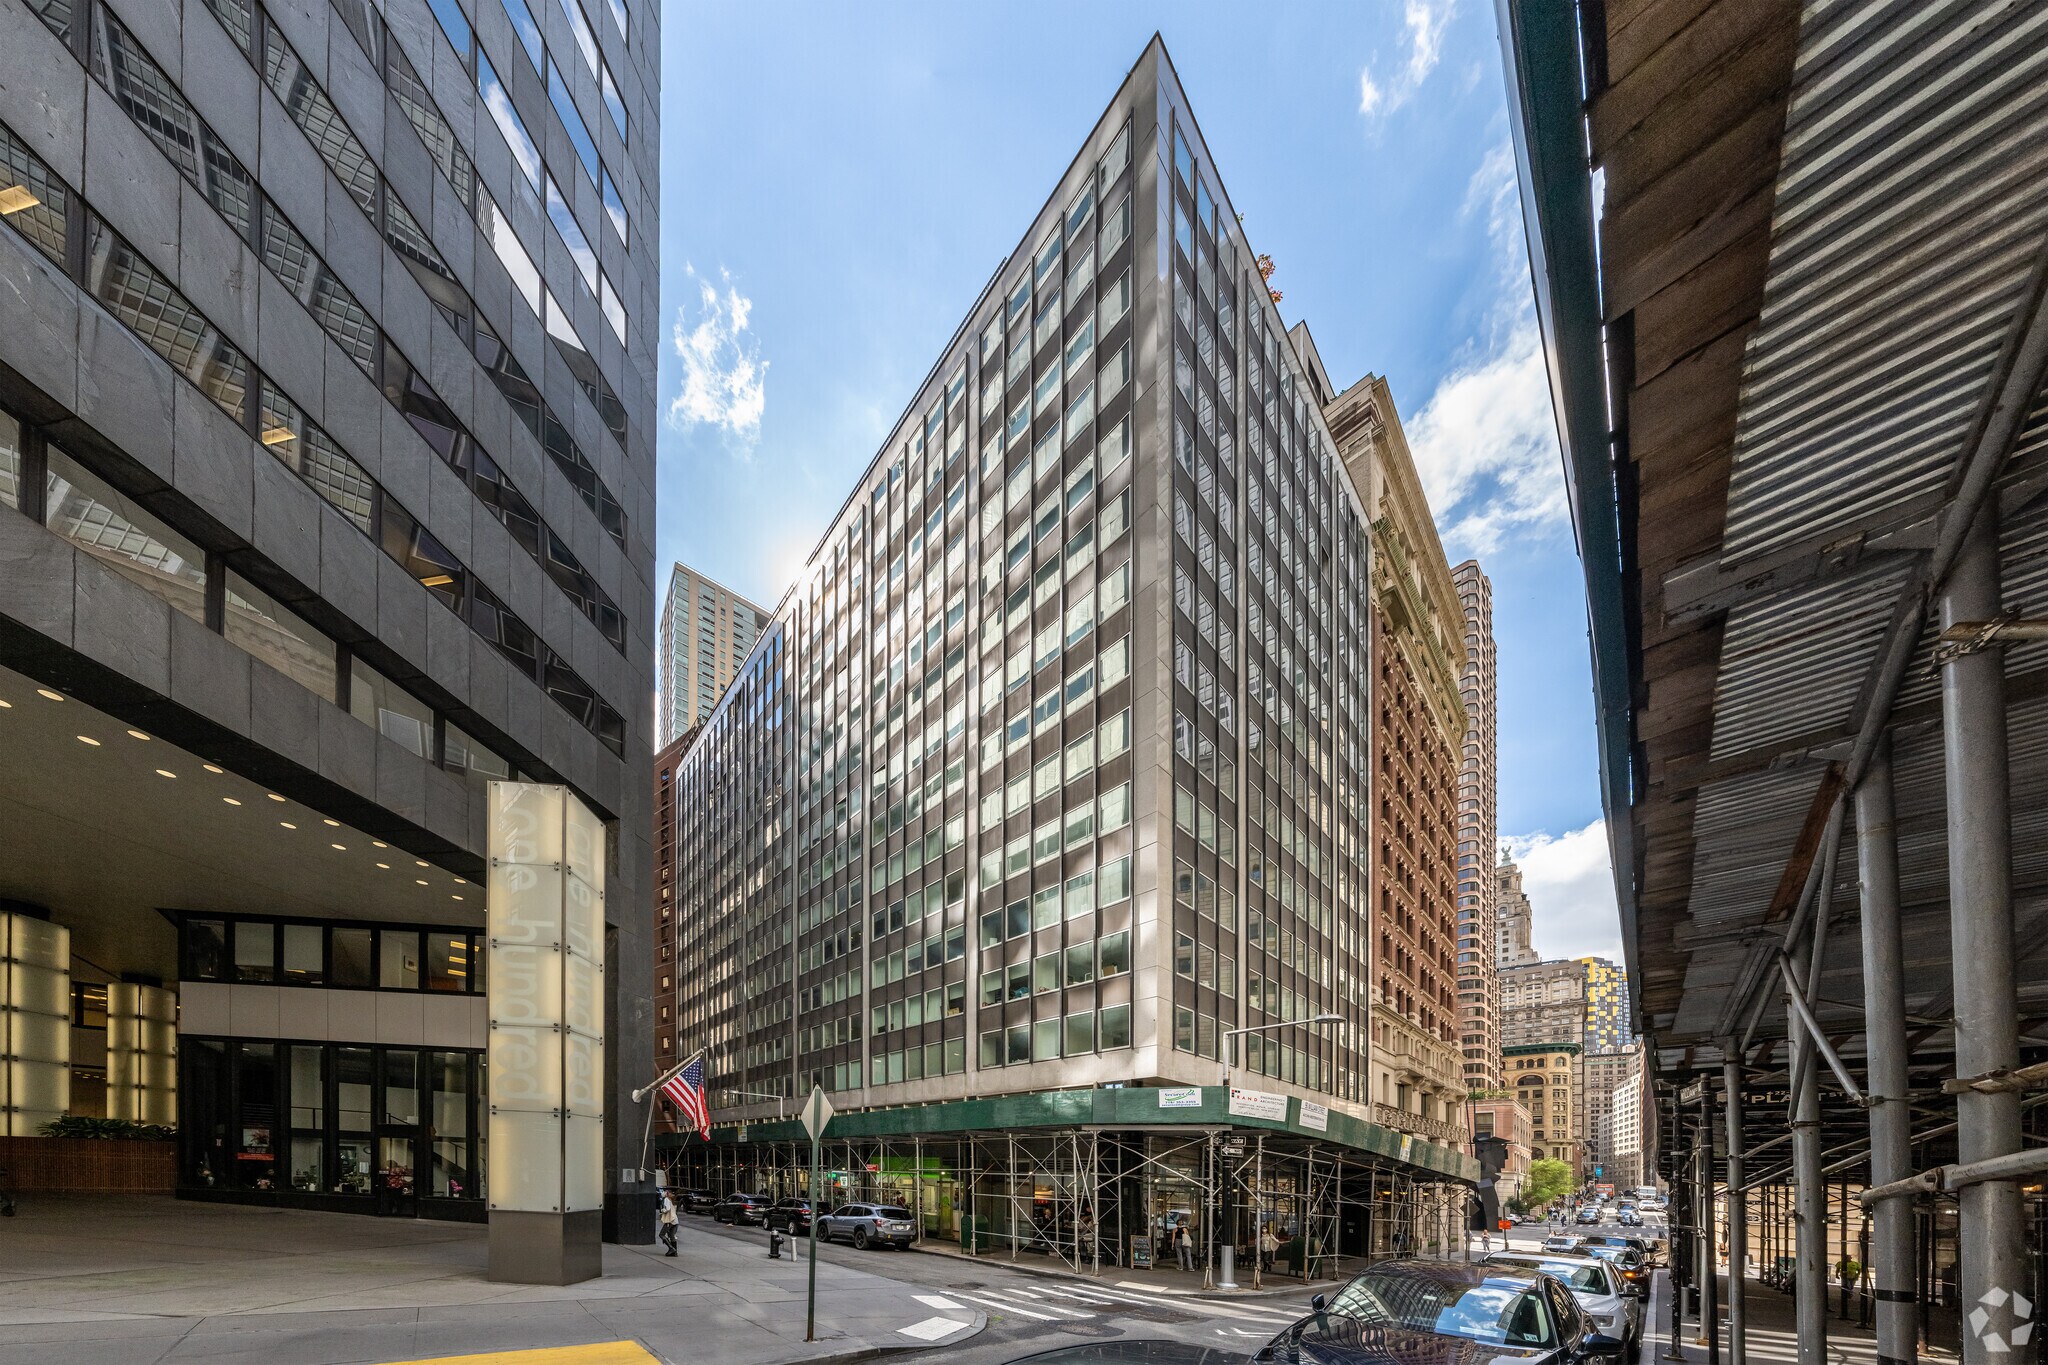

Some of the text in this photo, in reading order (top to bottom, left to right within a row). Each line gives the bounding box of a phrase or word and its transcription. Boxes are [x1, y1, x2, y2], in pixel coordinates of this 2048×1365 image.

[495, 807, 555, 1101] one hundred
[568, 826, 598, 1109] one hundred
[1751, 1092, 1827, 1104] PLAT
